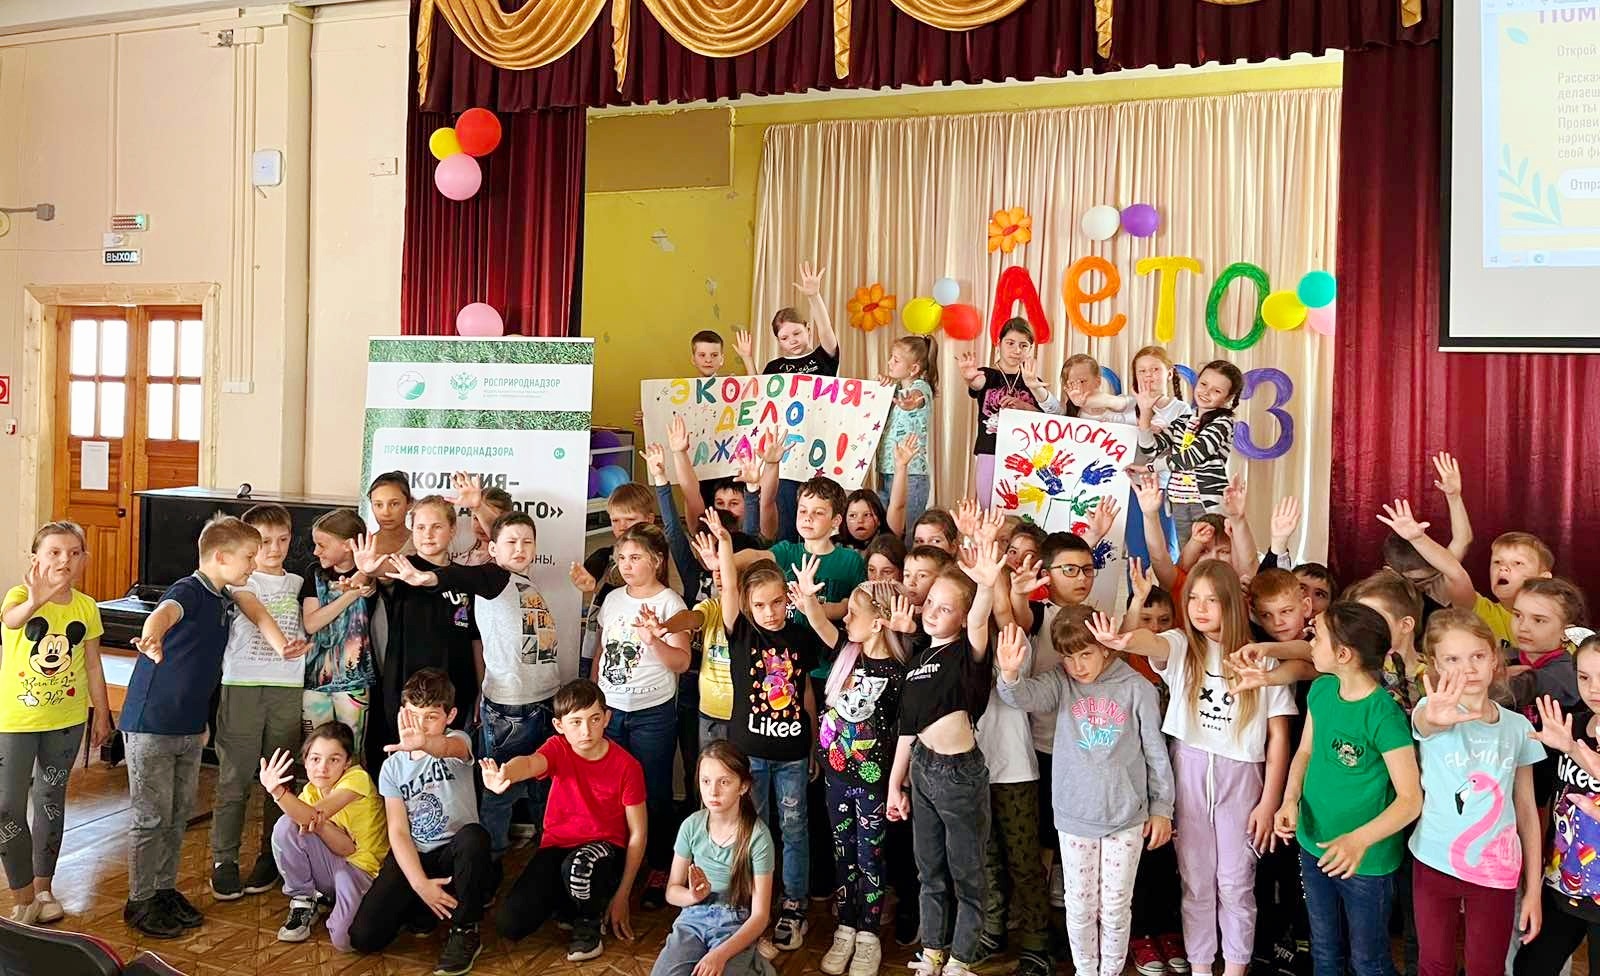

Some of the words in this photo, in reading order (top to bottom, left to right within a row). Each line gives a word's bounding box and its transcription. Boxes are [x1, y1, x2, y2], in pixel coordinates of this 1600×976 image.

[106, 252, 138, 262] ВЫХОД
[483, 377, 561, 388] РОСПРИРОДНАДЗОР
[715, 400, 805, 433] ДЕЛО
[384, 444, 419, 455] ПРЕМИЯ
[421, 445, 514, 457] РОСПРИРОДНАДЗОРА
[1011, 419, 1128, 463] ЭКОЛОГИЯ
[748, 712, 802, 738] Likee
[1557, 753, 1600, 792] likee
